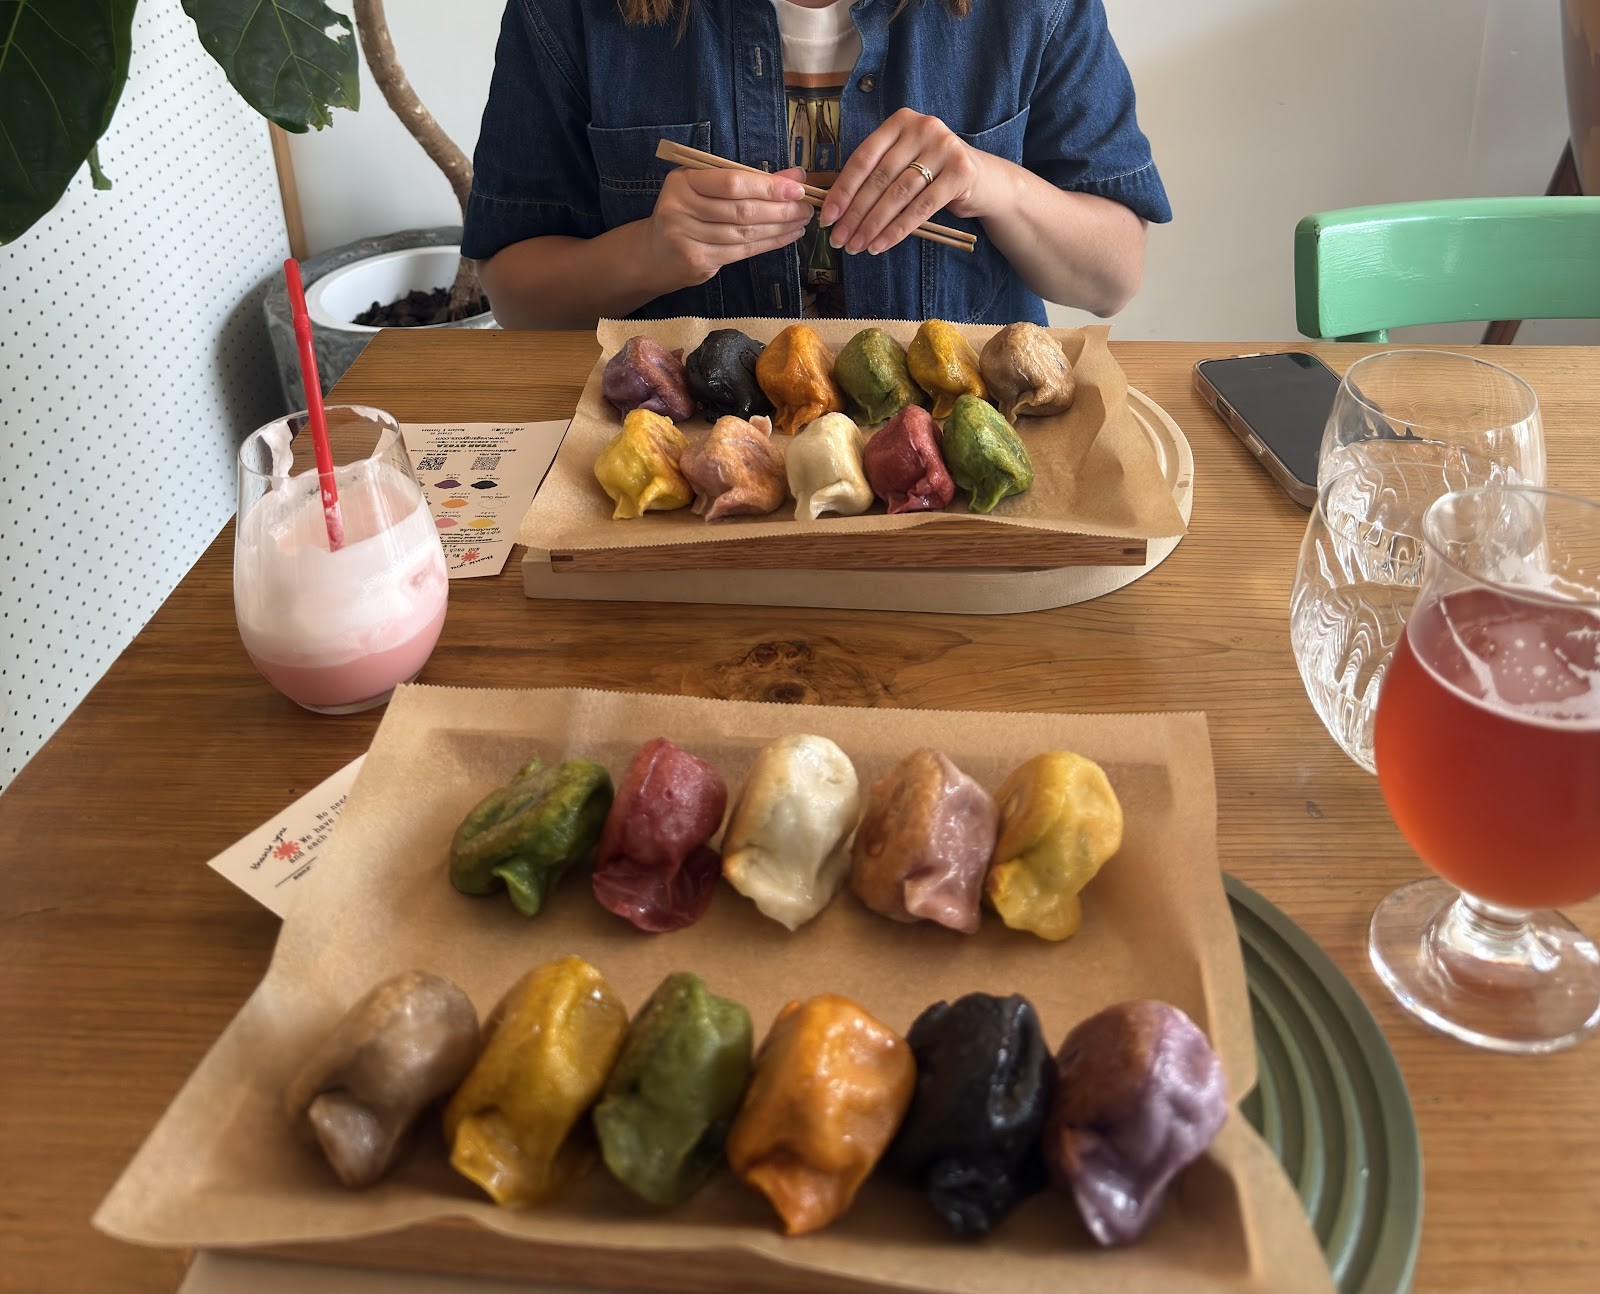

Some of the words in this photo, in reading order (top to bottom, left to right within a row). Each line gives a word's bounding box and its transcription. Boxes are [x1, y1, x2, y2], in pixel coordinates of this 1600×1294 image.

[316, 811, 329, 820] No
[298, 834, 313, 843] We
[312, 818, 334, 833] have
[288, 850, 305, 864] and
[307, 834, 328, 850] each
